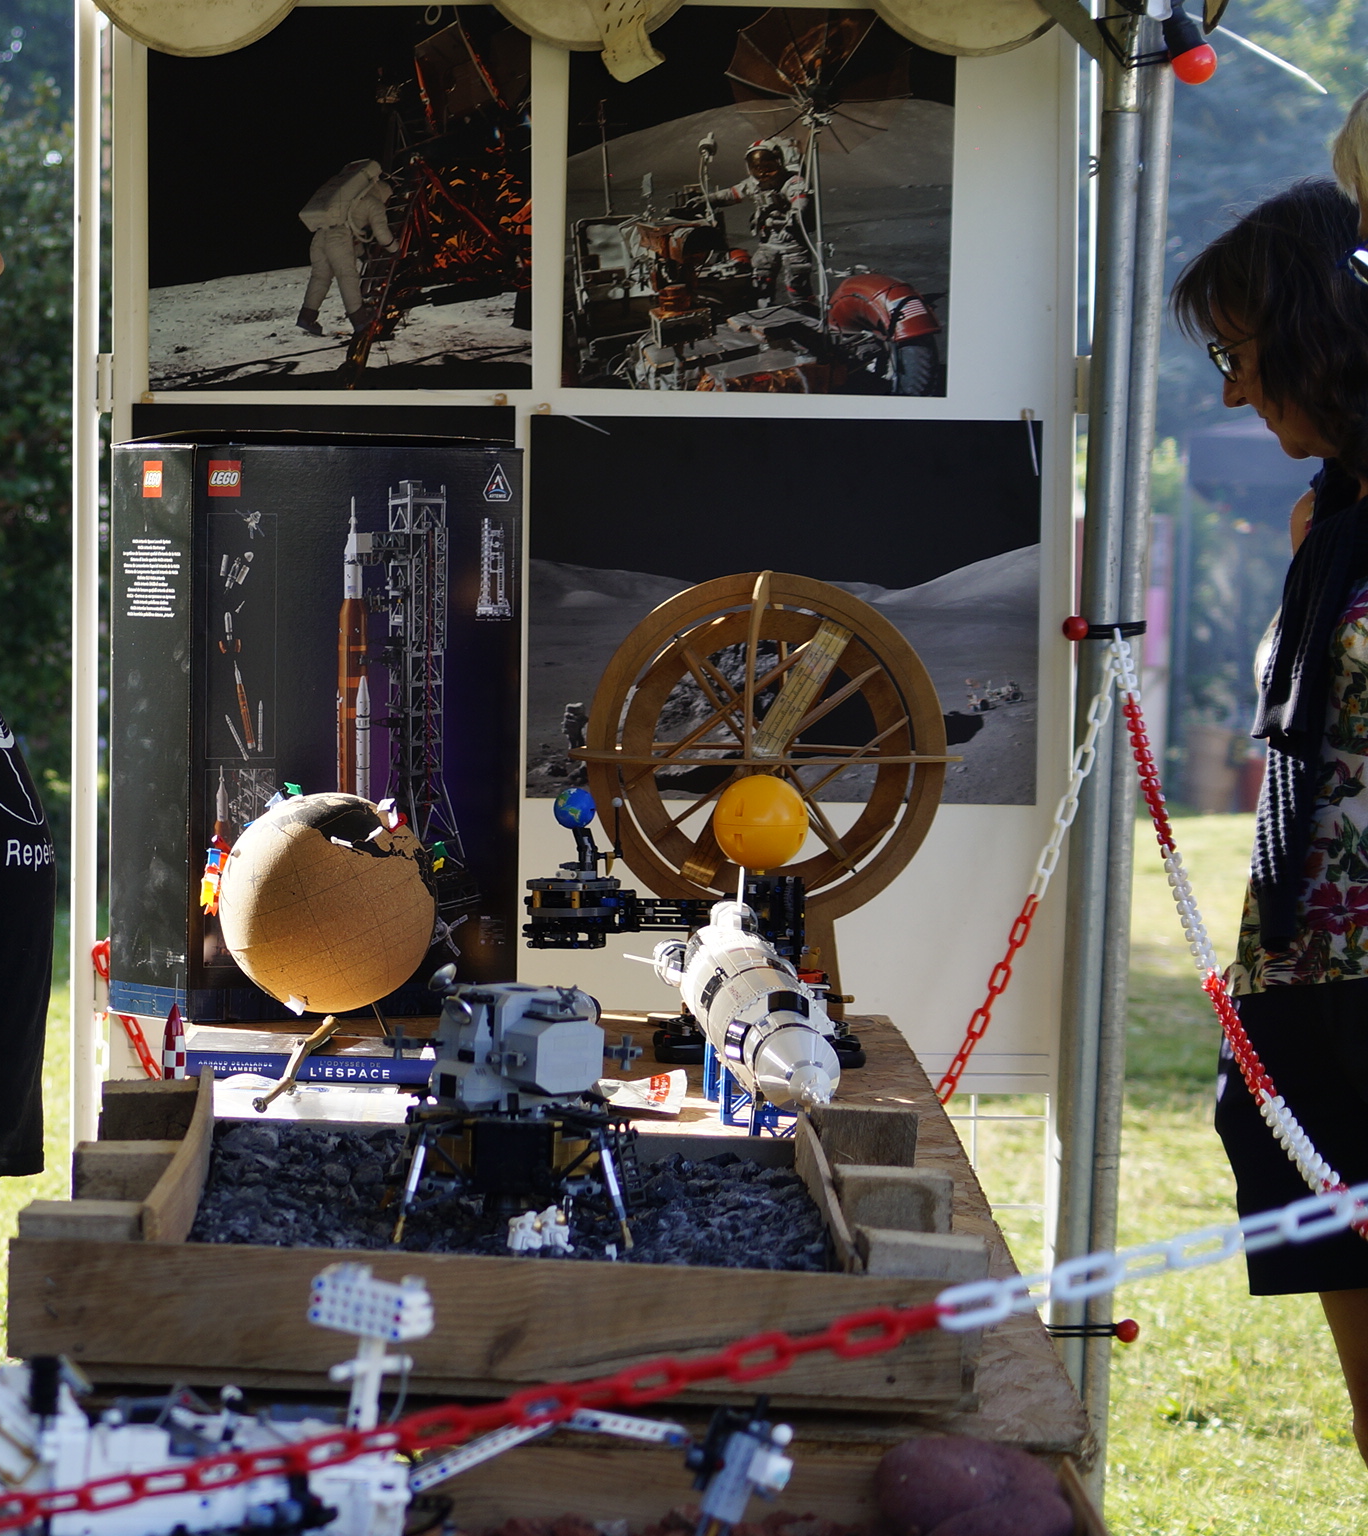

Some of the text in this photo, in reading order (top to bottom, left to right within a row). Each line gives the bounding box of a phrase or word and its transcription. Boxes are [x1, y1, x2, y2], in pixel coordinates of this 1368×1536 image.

[144, 471, 162, 487] LEGO
[209, 470, 240, 486] LEGO
[319, 1060, 366, 1068] L'ODYSSÉE
[310, 1067, 391, 1079] L'ESPACE
